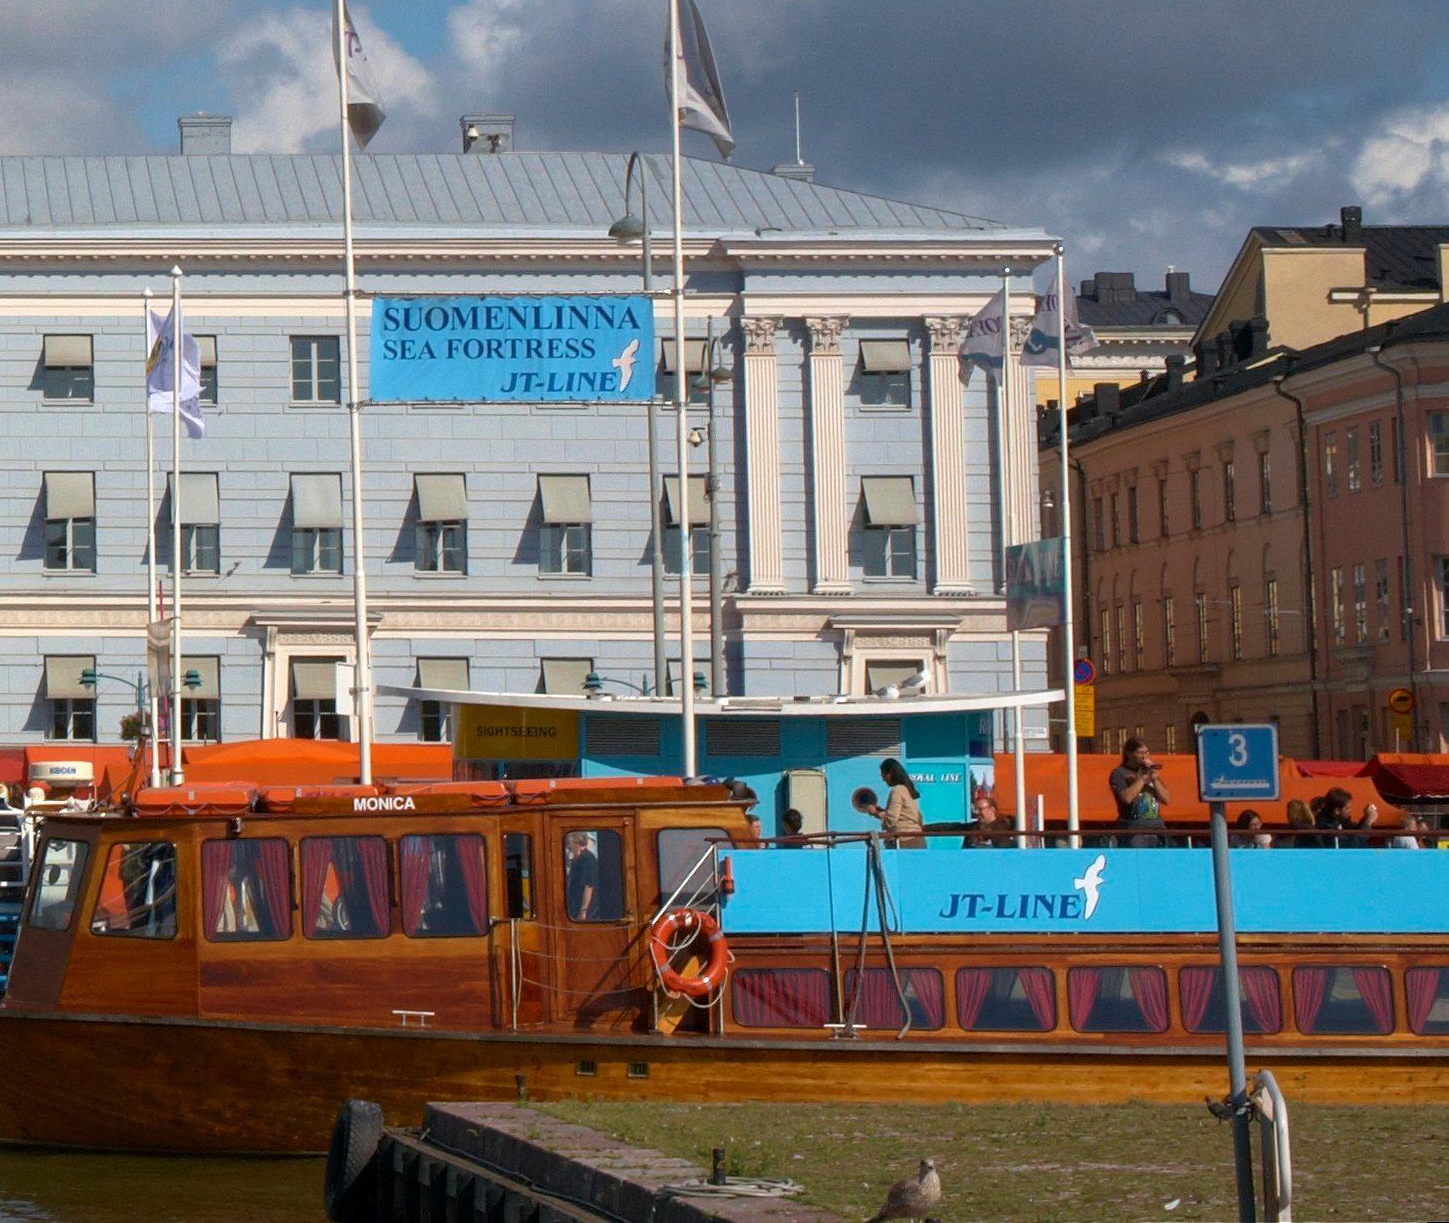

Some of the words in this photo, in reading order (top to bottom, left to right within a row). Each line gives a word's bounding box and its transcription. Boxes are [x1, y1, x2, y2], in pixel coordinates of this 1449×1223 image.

[383, 305, 641, 332] SUOMENLINNA
[383, 339, 436, 361] SEA
[446, 337, 596, 360] FORTRESS
[500, 371, 618, 394] JT-LINE
[477, 725, 557, 738] SIGHTSEEING
[1228, 733, 1248, 767] 3
[941, 773, 961, 782] LINE
[353, 796, 416, 811] MONICA
[938, 893, 1082, 919] JT-LINE
